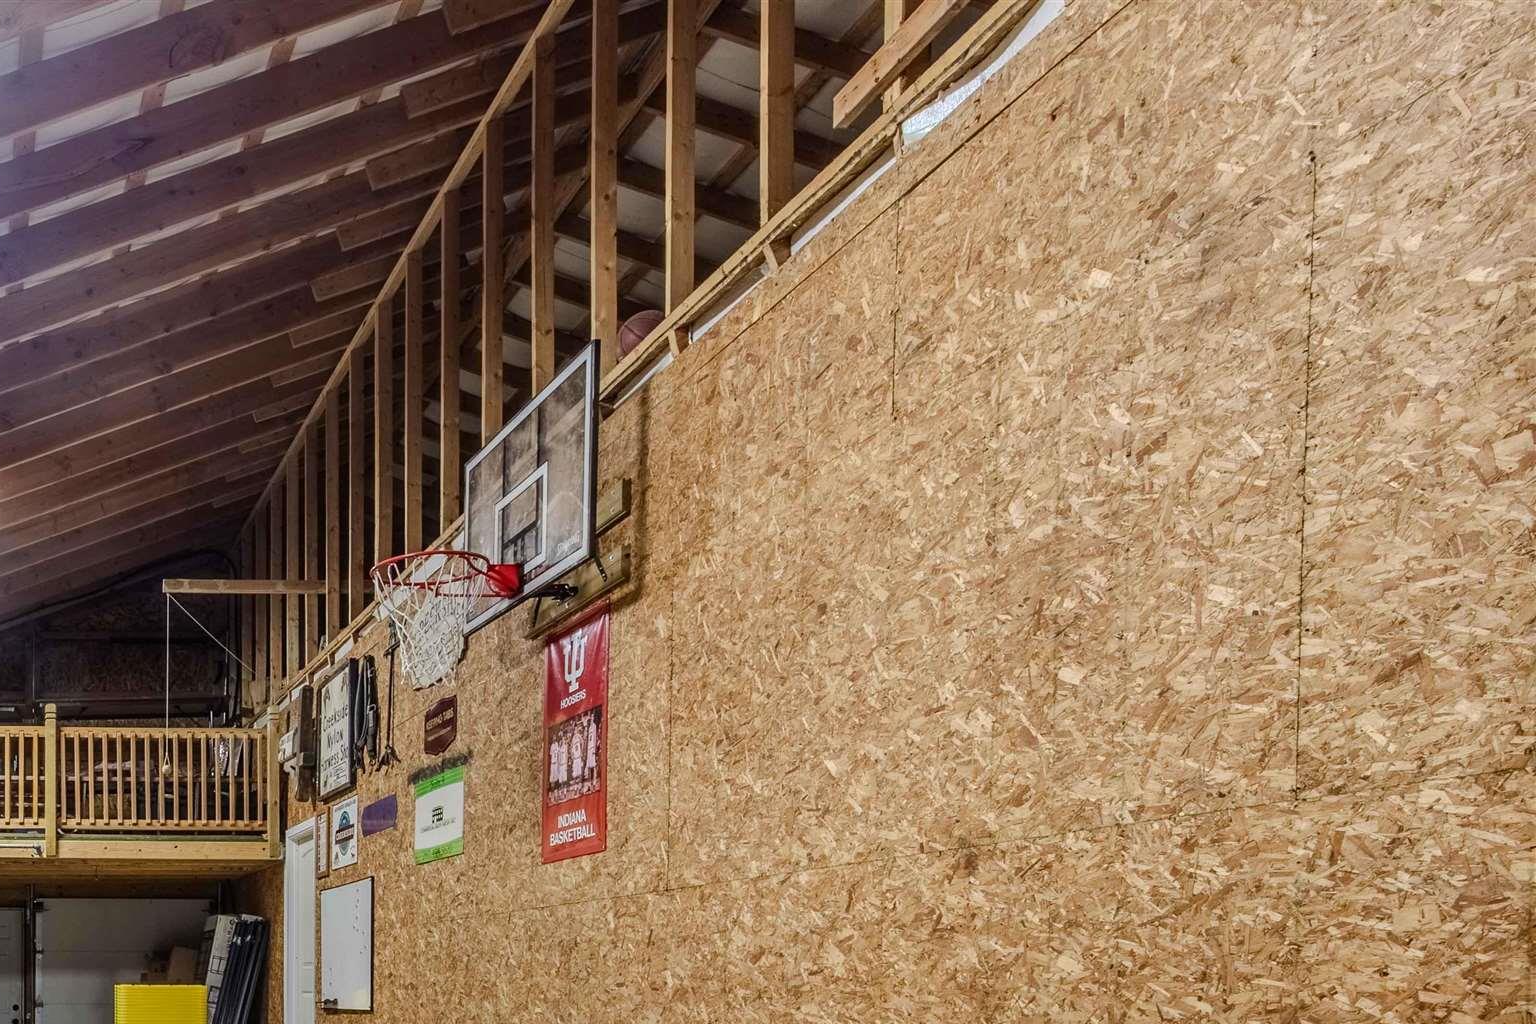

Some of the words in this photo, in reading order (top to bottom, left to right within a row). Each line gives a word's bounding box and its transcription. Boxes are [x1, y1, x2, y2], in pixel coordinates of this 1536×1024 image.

[560, 688, 586, 710] HOOSIERS
[558, 808, 586, 829] INDIANA
[550, 823, 596, 847] BASKETBALL
